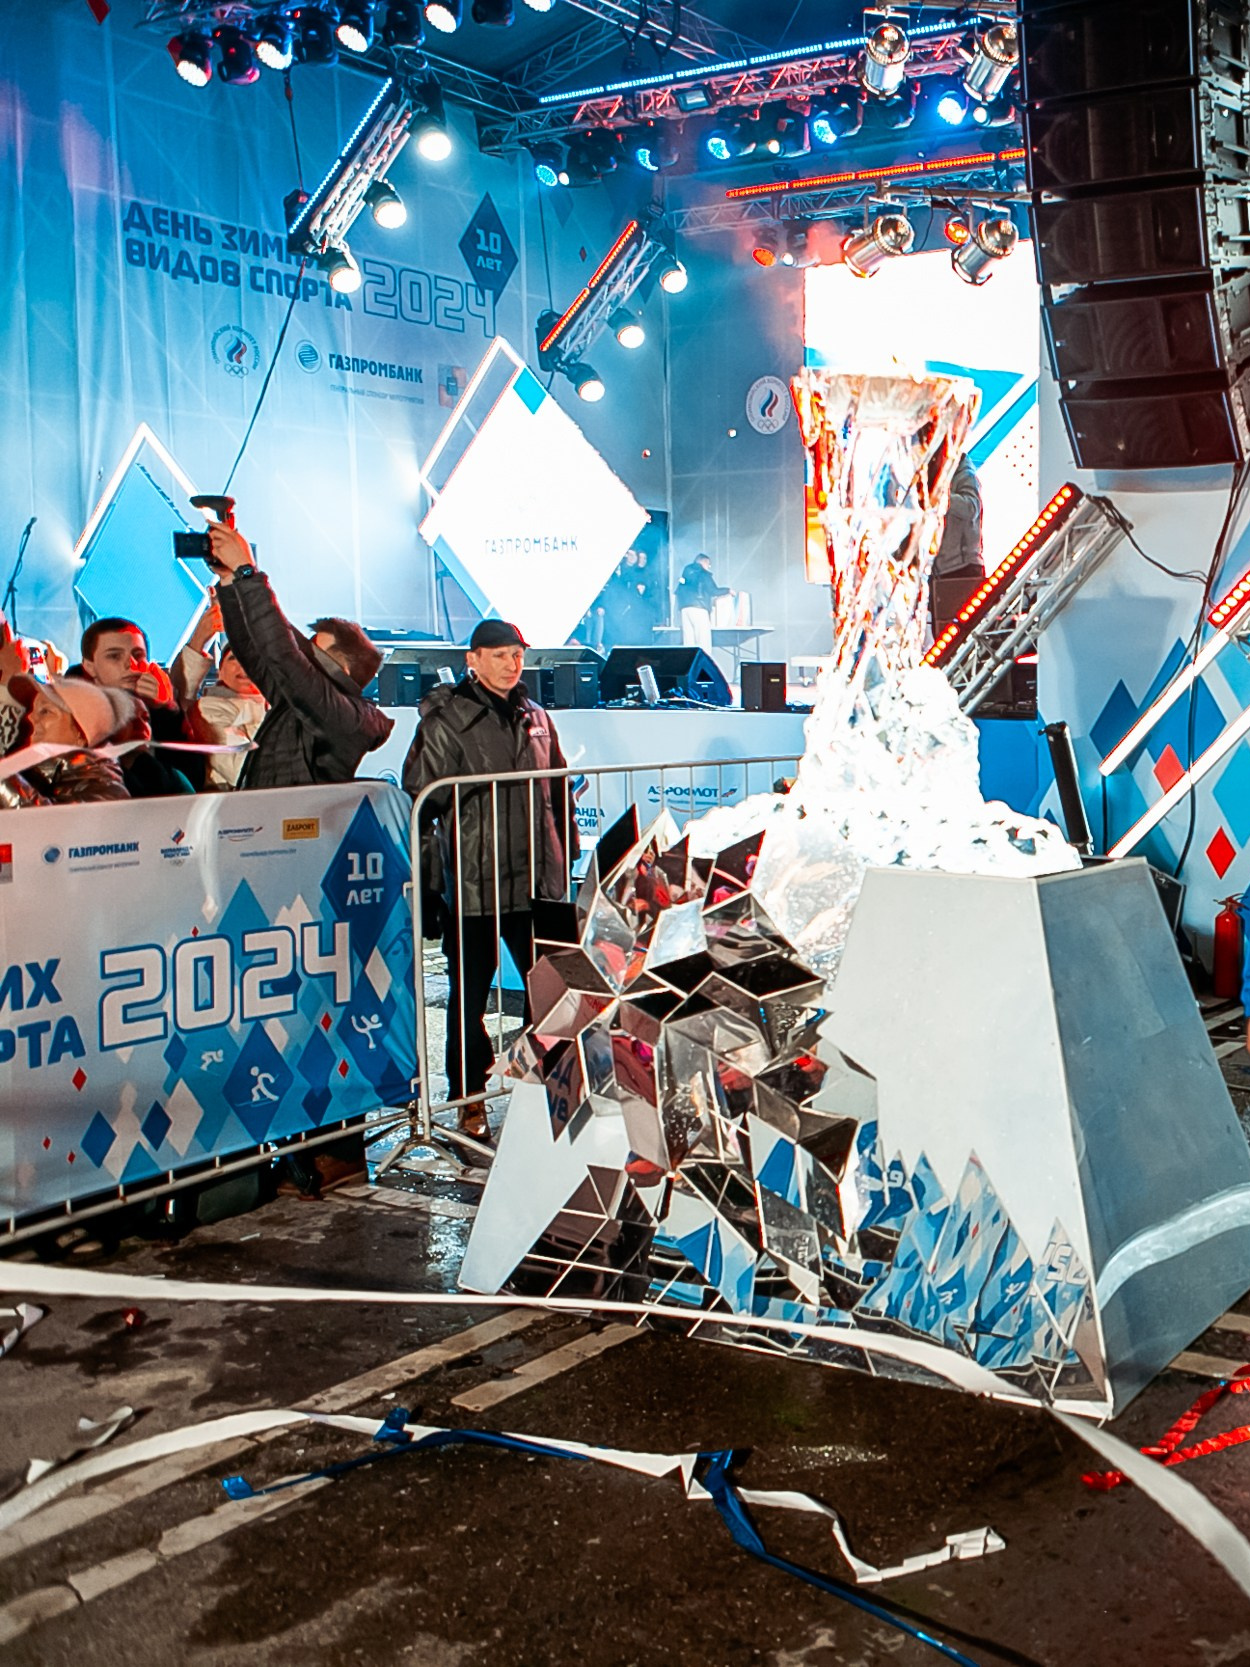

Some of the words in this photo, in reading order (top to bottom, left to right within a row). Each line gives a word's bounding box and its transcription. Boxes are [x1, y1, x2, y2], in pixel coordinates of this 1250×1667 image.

[123, 202, 212, 246] ДЕНЬ
[475, 228, 502, 255] 10
[125, 237, 241, 287] ВИДОВ
[363, 258, 496, 339] 2024
[328, 353, 423, 384] ГАЗПРОМБАНК
[485, 536, 578, 554] ГАЗПРОМБАНК
[574, 807, 605, 818] АНДА
[576, 818, 599, 827] СИИ
[68, 841, 140, 859] ГАЗПРОМБАНК
[347, 852, 384, 882] 10
[100, 920, 352, 1052] 2024
